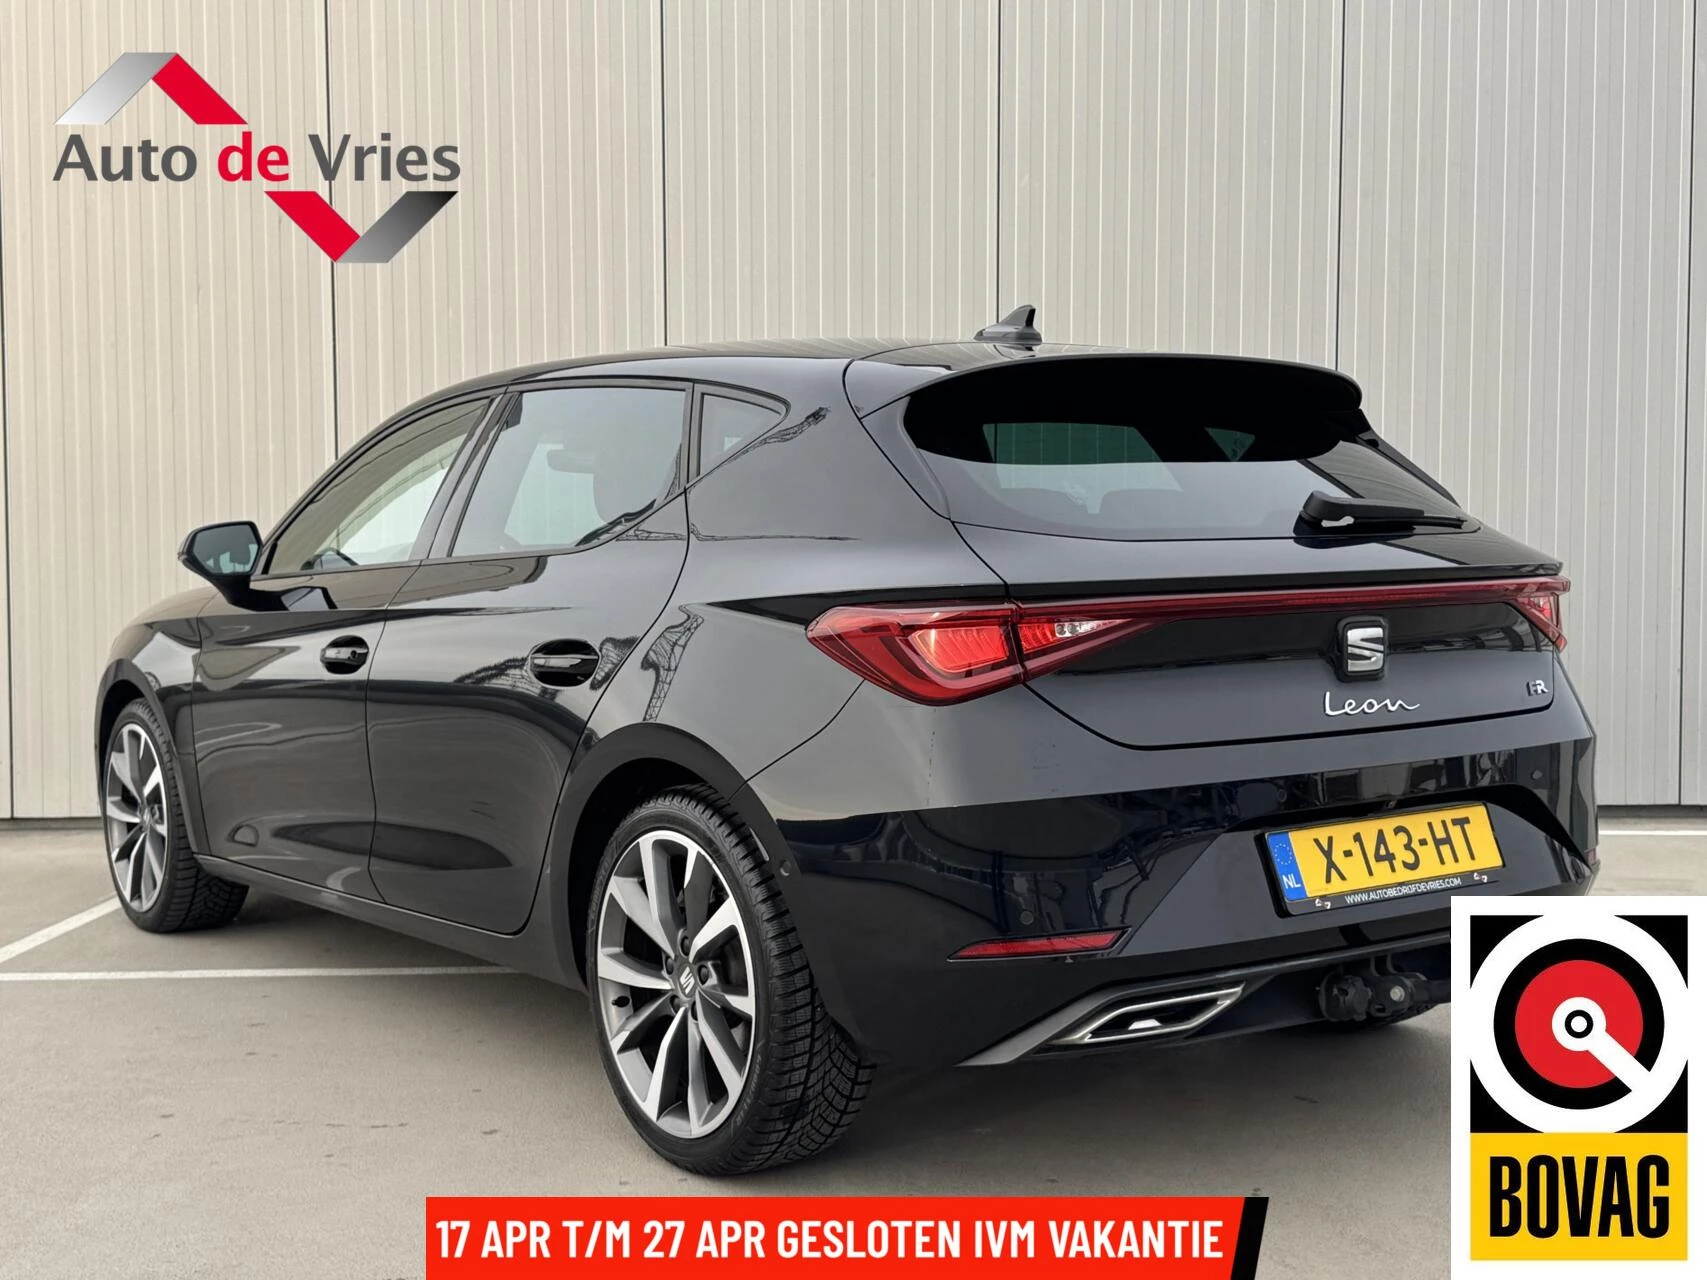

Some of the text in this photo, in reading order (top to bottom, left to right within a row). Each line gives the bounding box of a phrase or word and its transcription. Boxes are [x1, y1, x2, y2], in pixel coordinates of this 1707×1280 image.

[1324, 691, 1420, 716] Leon
[1313, 816, 1476, 884] X-143-HT
[1282, 873, 1302, 890] NL
